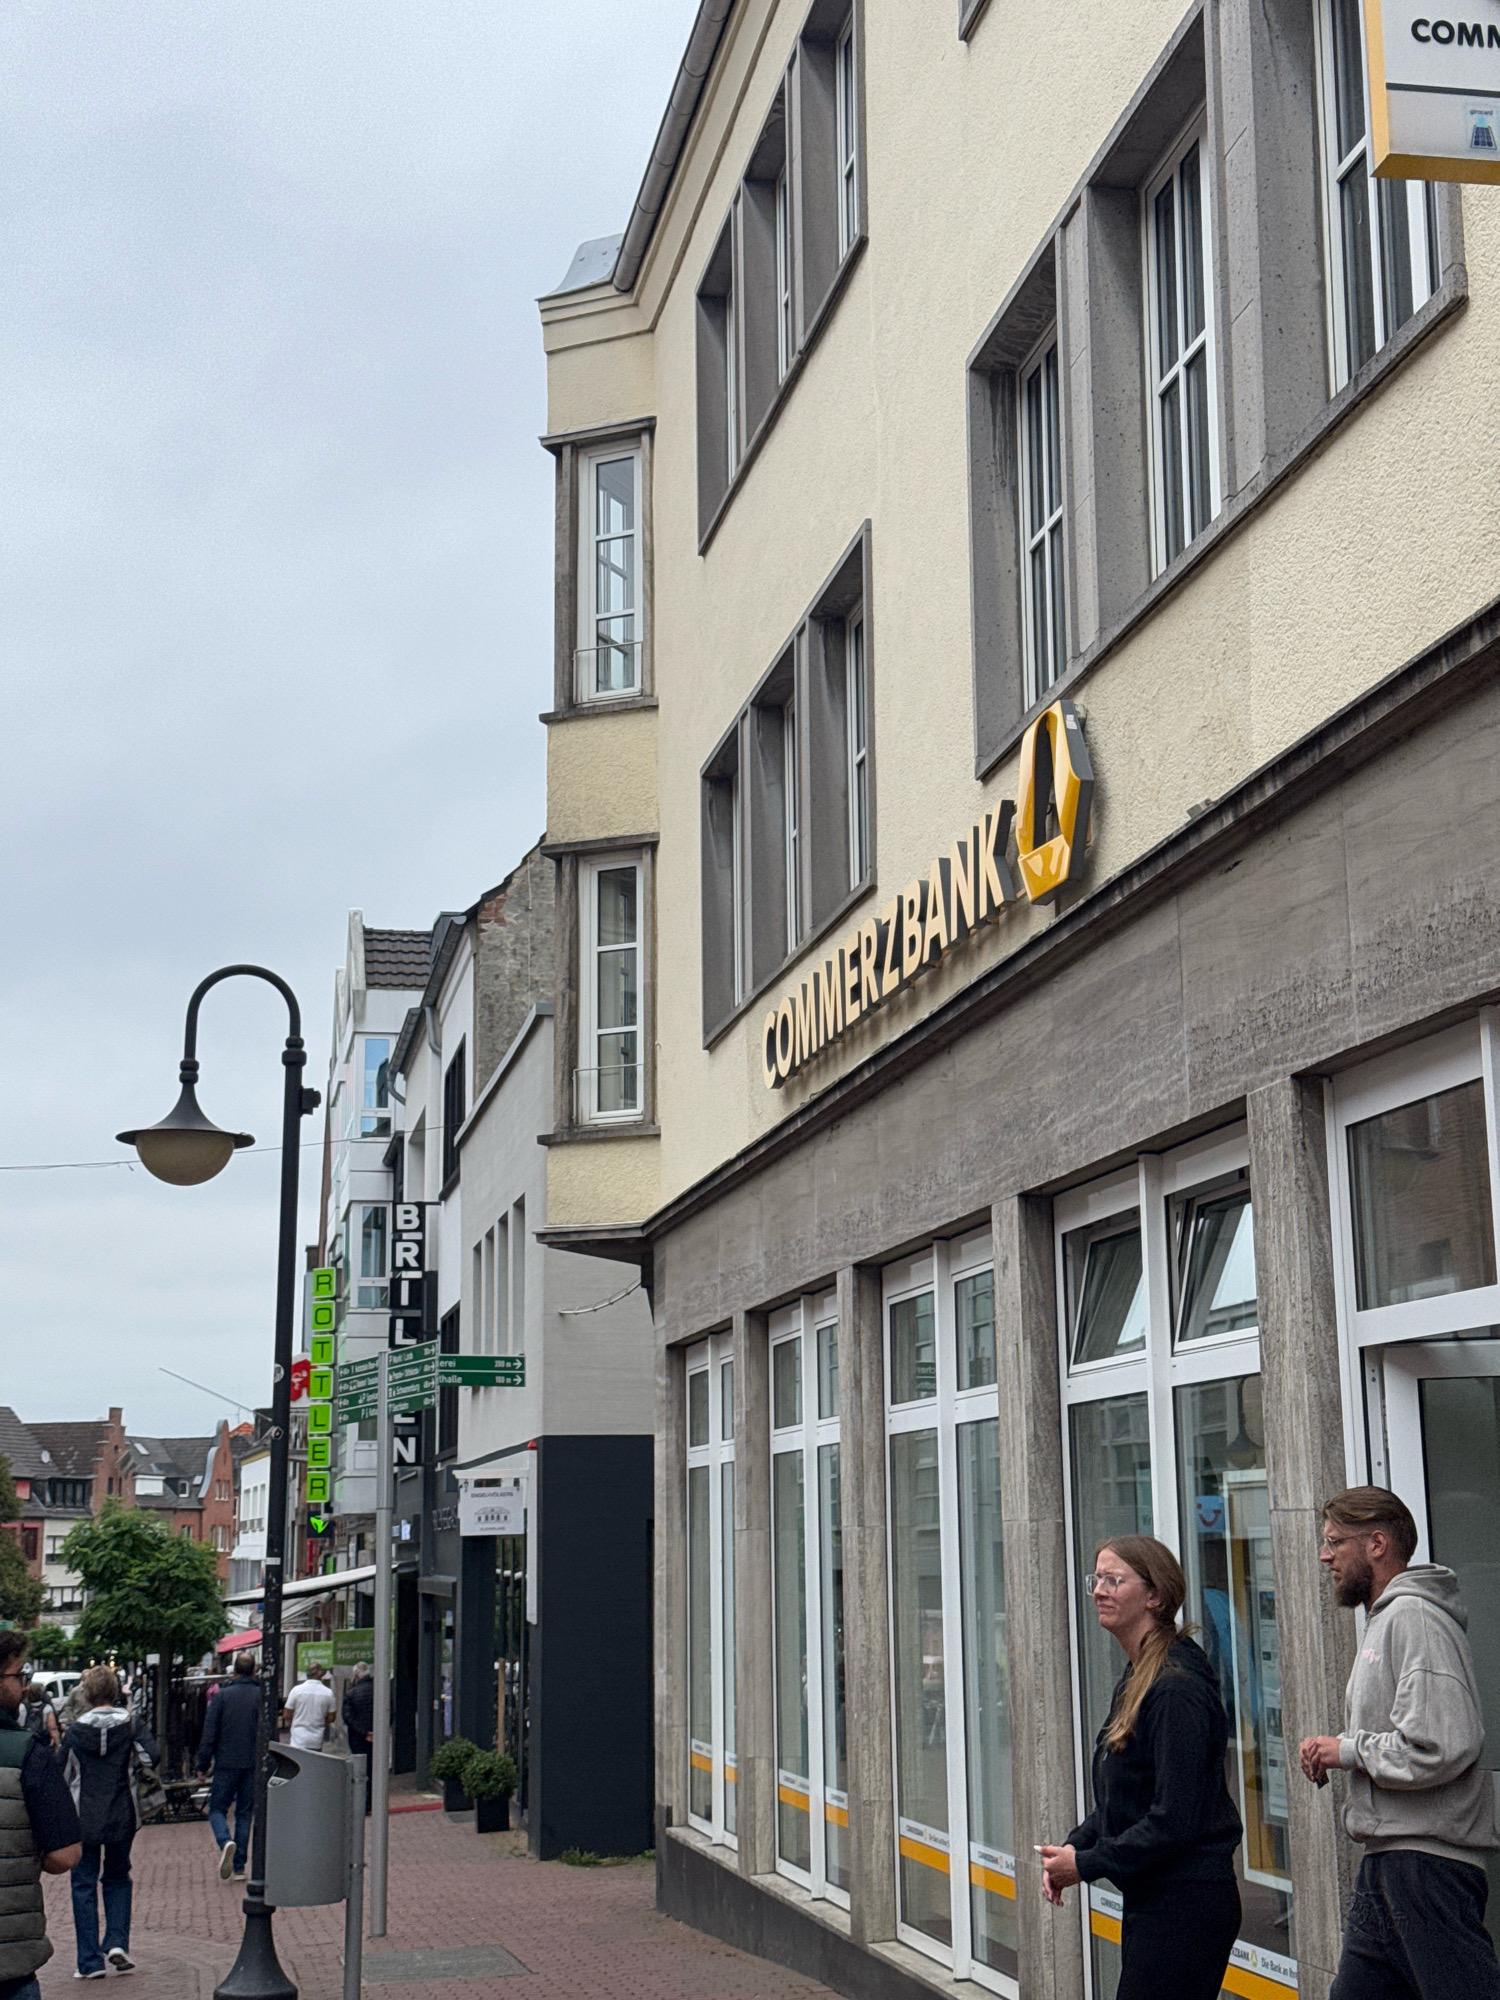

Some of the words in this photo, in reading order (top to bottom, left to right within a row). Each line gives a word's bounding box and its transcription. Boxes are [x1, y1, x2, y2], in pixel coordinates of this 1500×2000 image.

[761, 799, 1015, 1090] COMMERZBANK
[309, 1274, 332, 1495] ROTTLER
[393, 1204, 420, 1464] BRILN
[337, 1649, 375, 1660] Hörtes
